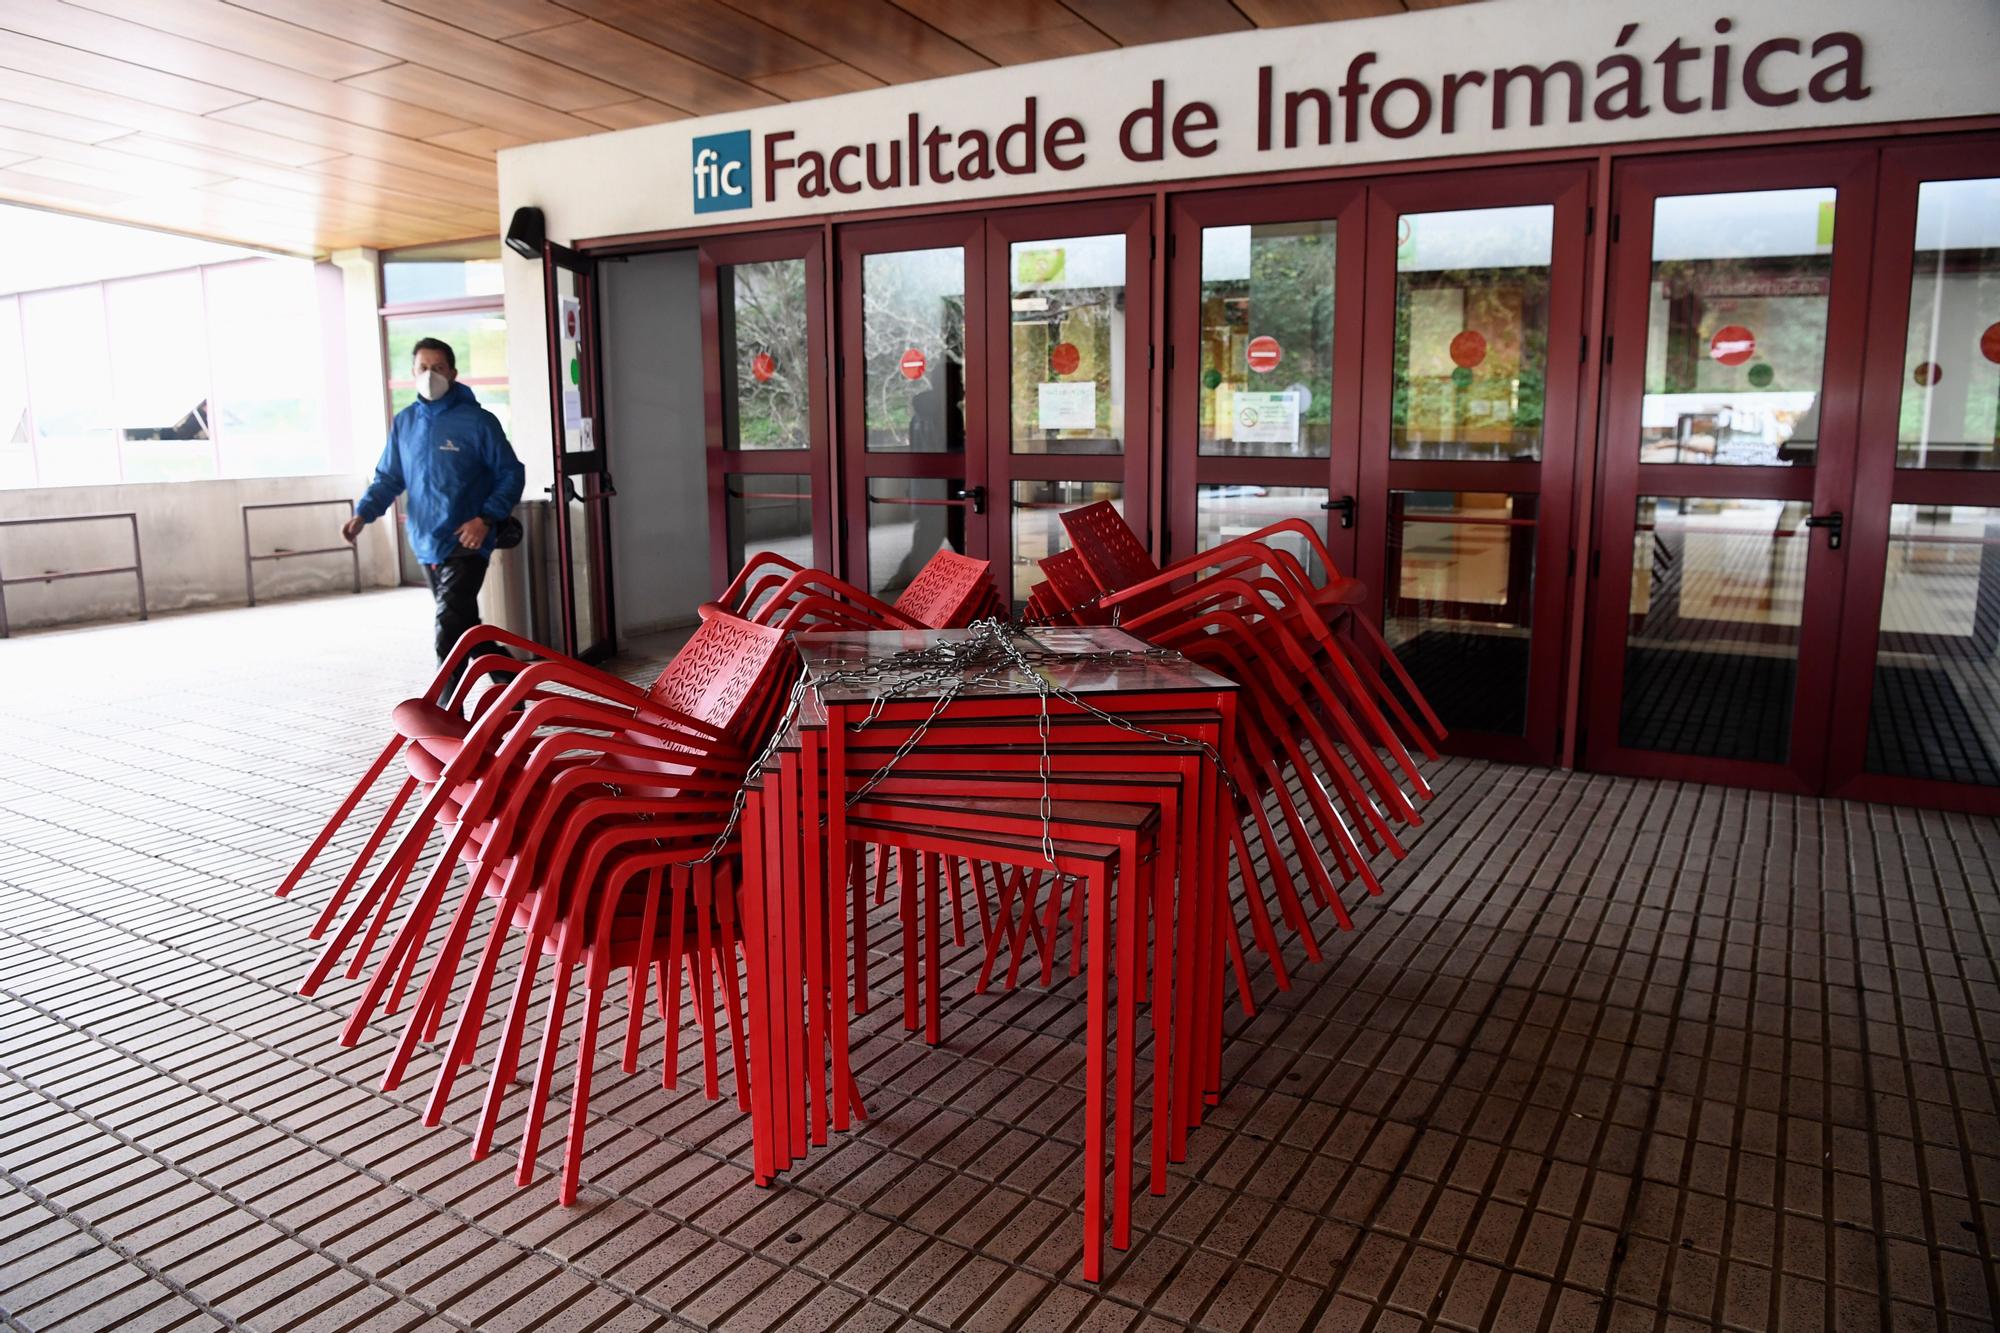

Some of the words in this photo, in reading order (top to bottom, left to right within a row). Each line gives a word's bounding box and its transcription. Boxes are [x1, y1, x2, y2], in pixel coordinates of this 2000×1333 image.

[765, 96, 1088, 203] Facultade
[1118, 78, 1219, 163] de
[1257, 17, 1874, 152] Informática
[694, 149, 742, 199] fic
